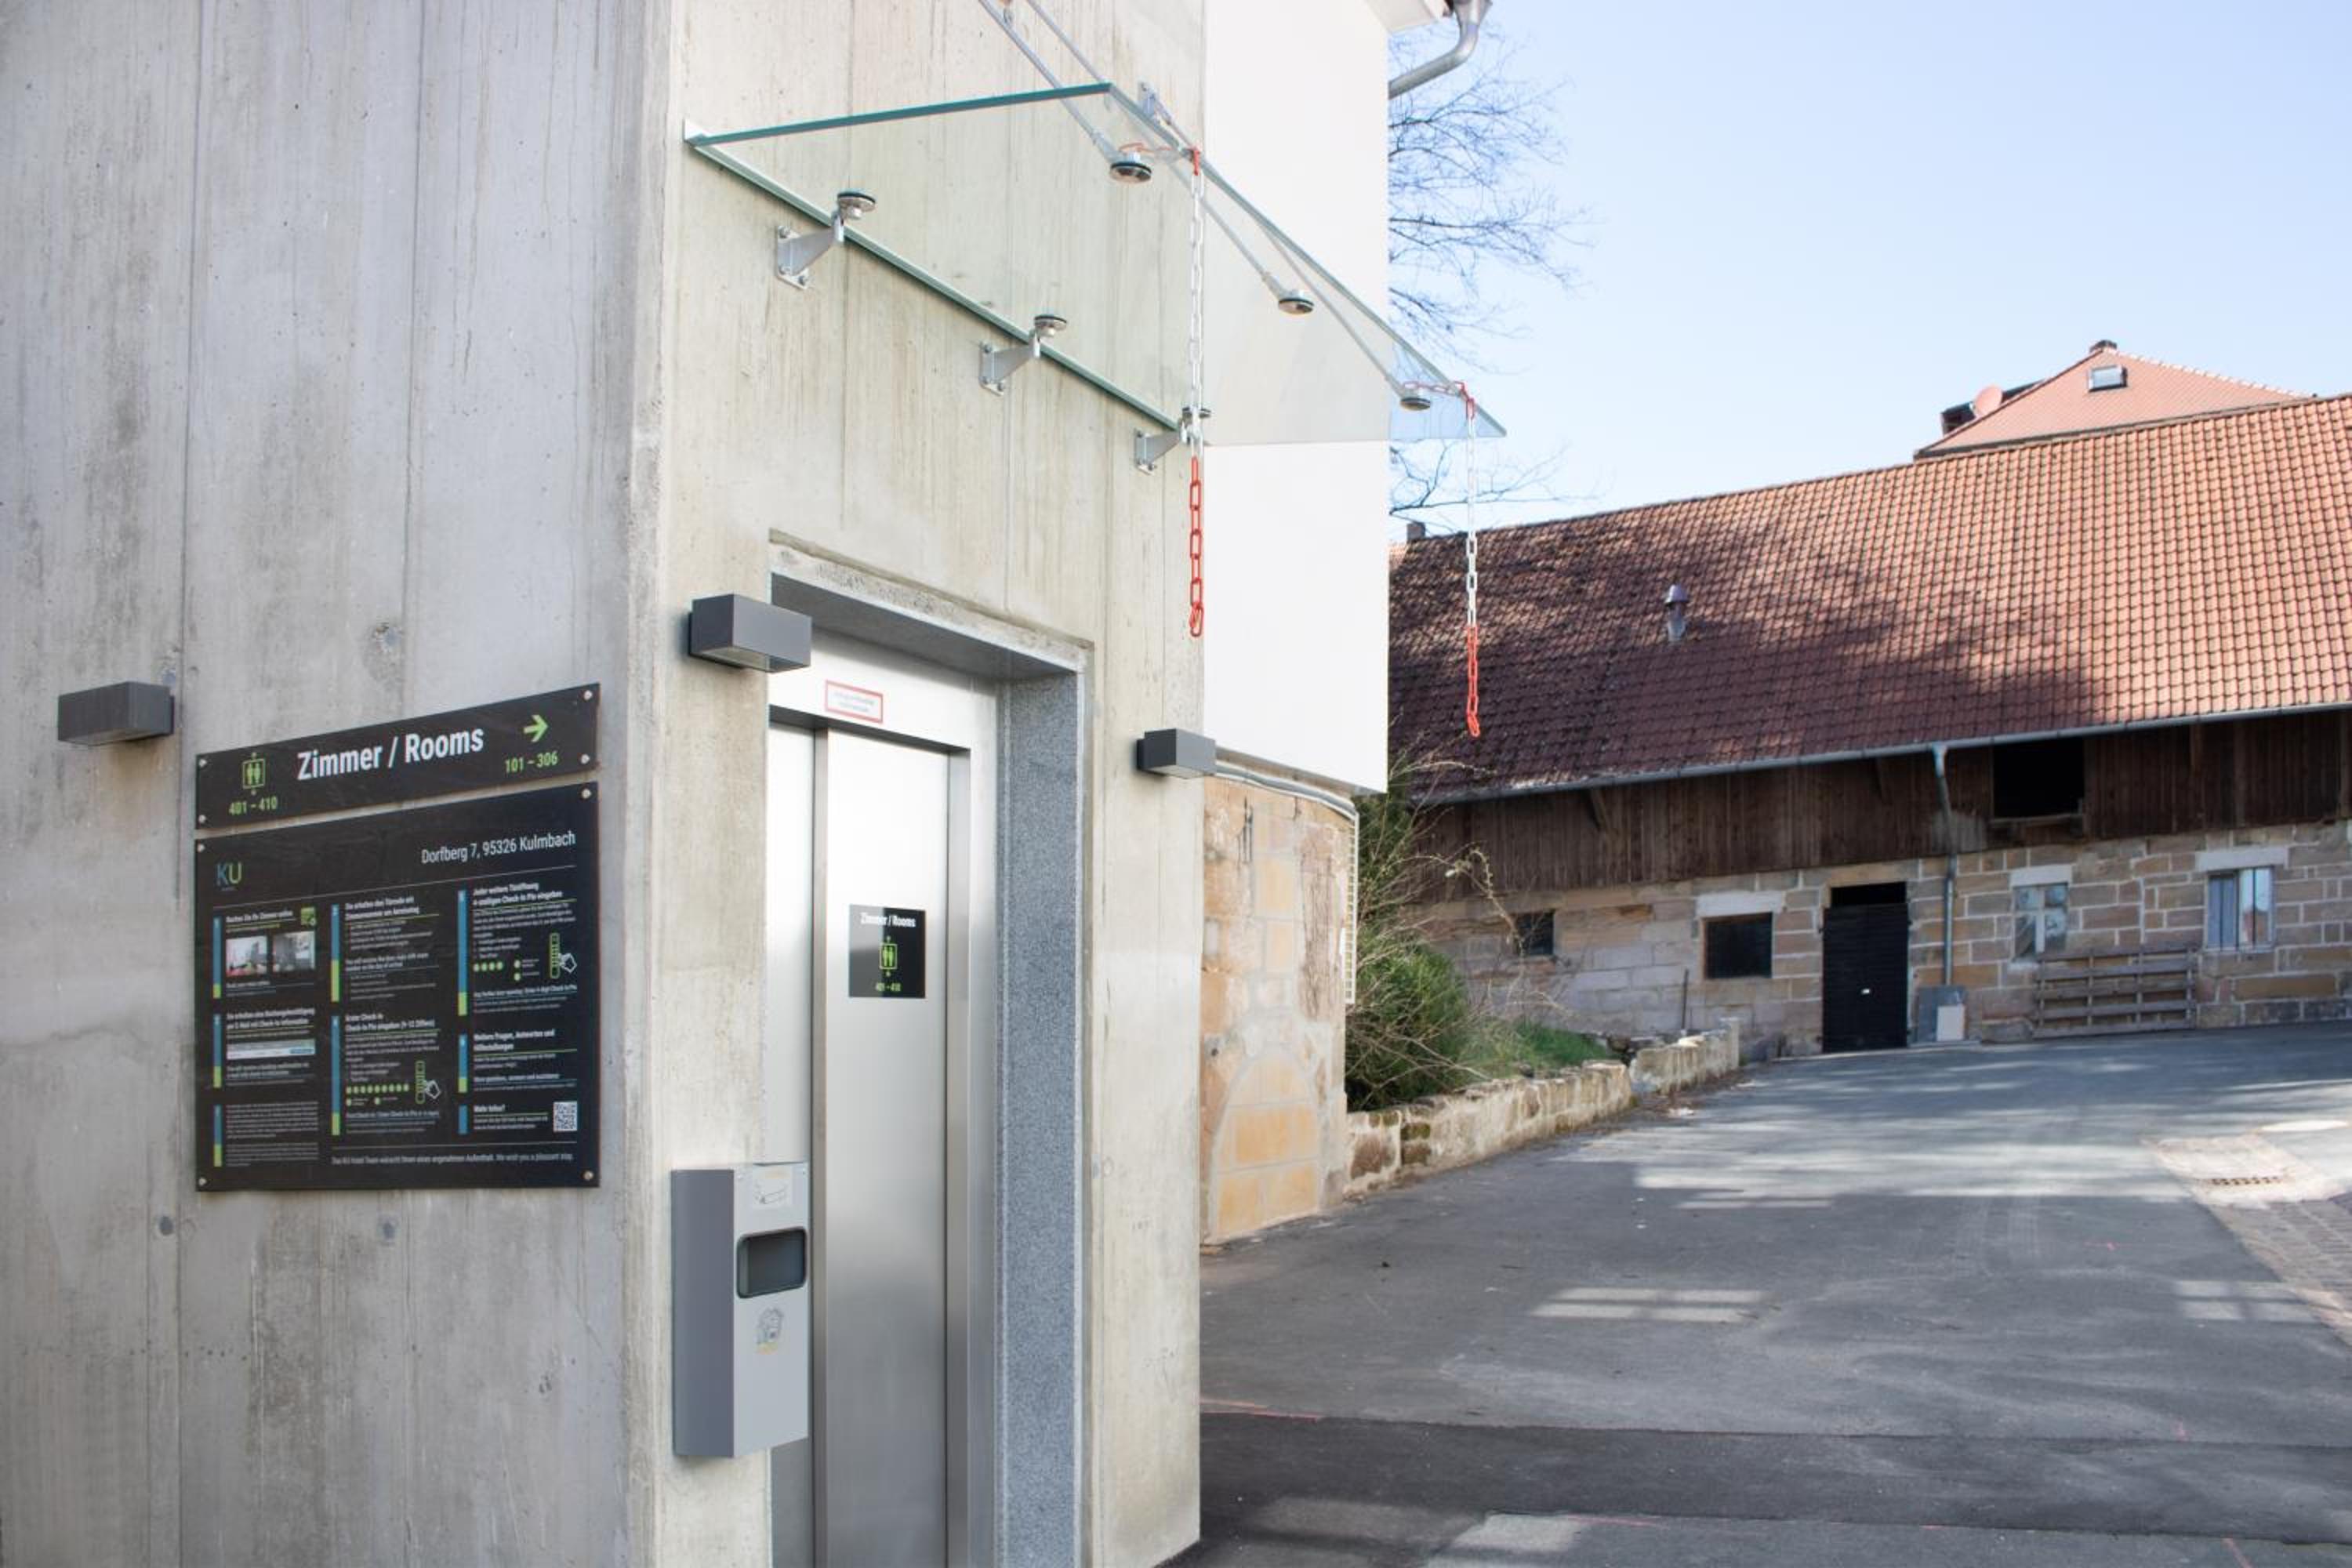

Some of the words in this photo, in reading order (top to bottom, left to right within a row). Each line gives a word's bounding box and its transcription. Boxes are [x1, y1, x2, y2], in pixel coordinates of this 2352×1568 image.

[297, 746, 383, 781] Zimmer
[388, 736, 399, 768] /
[405, 728, 485, 763] Rooms
[504, 757, 524, 774] 101
[537, 751, 558, 768] 306
[229, 800, 248, 816] 401
[259, 796, 278, 811] 410
[422, 846, 468, 864] Dorfberg
[470, 844, 481, 859] 7,
[482, 837, 517, 857] 95326
[520, 829, 576, 851] Kulmbach
[216, 862, 243, 886] KU
[892, 914, 916, 927] Rooms
